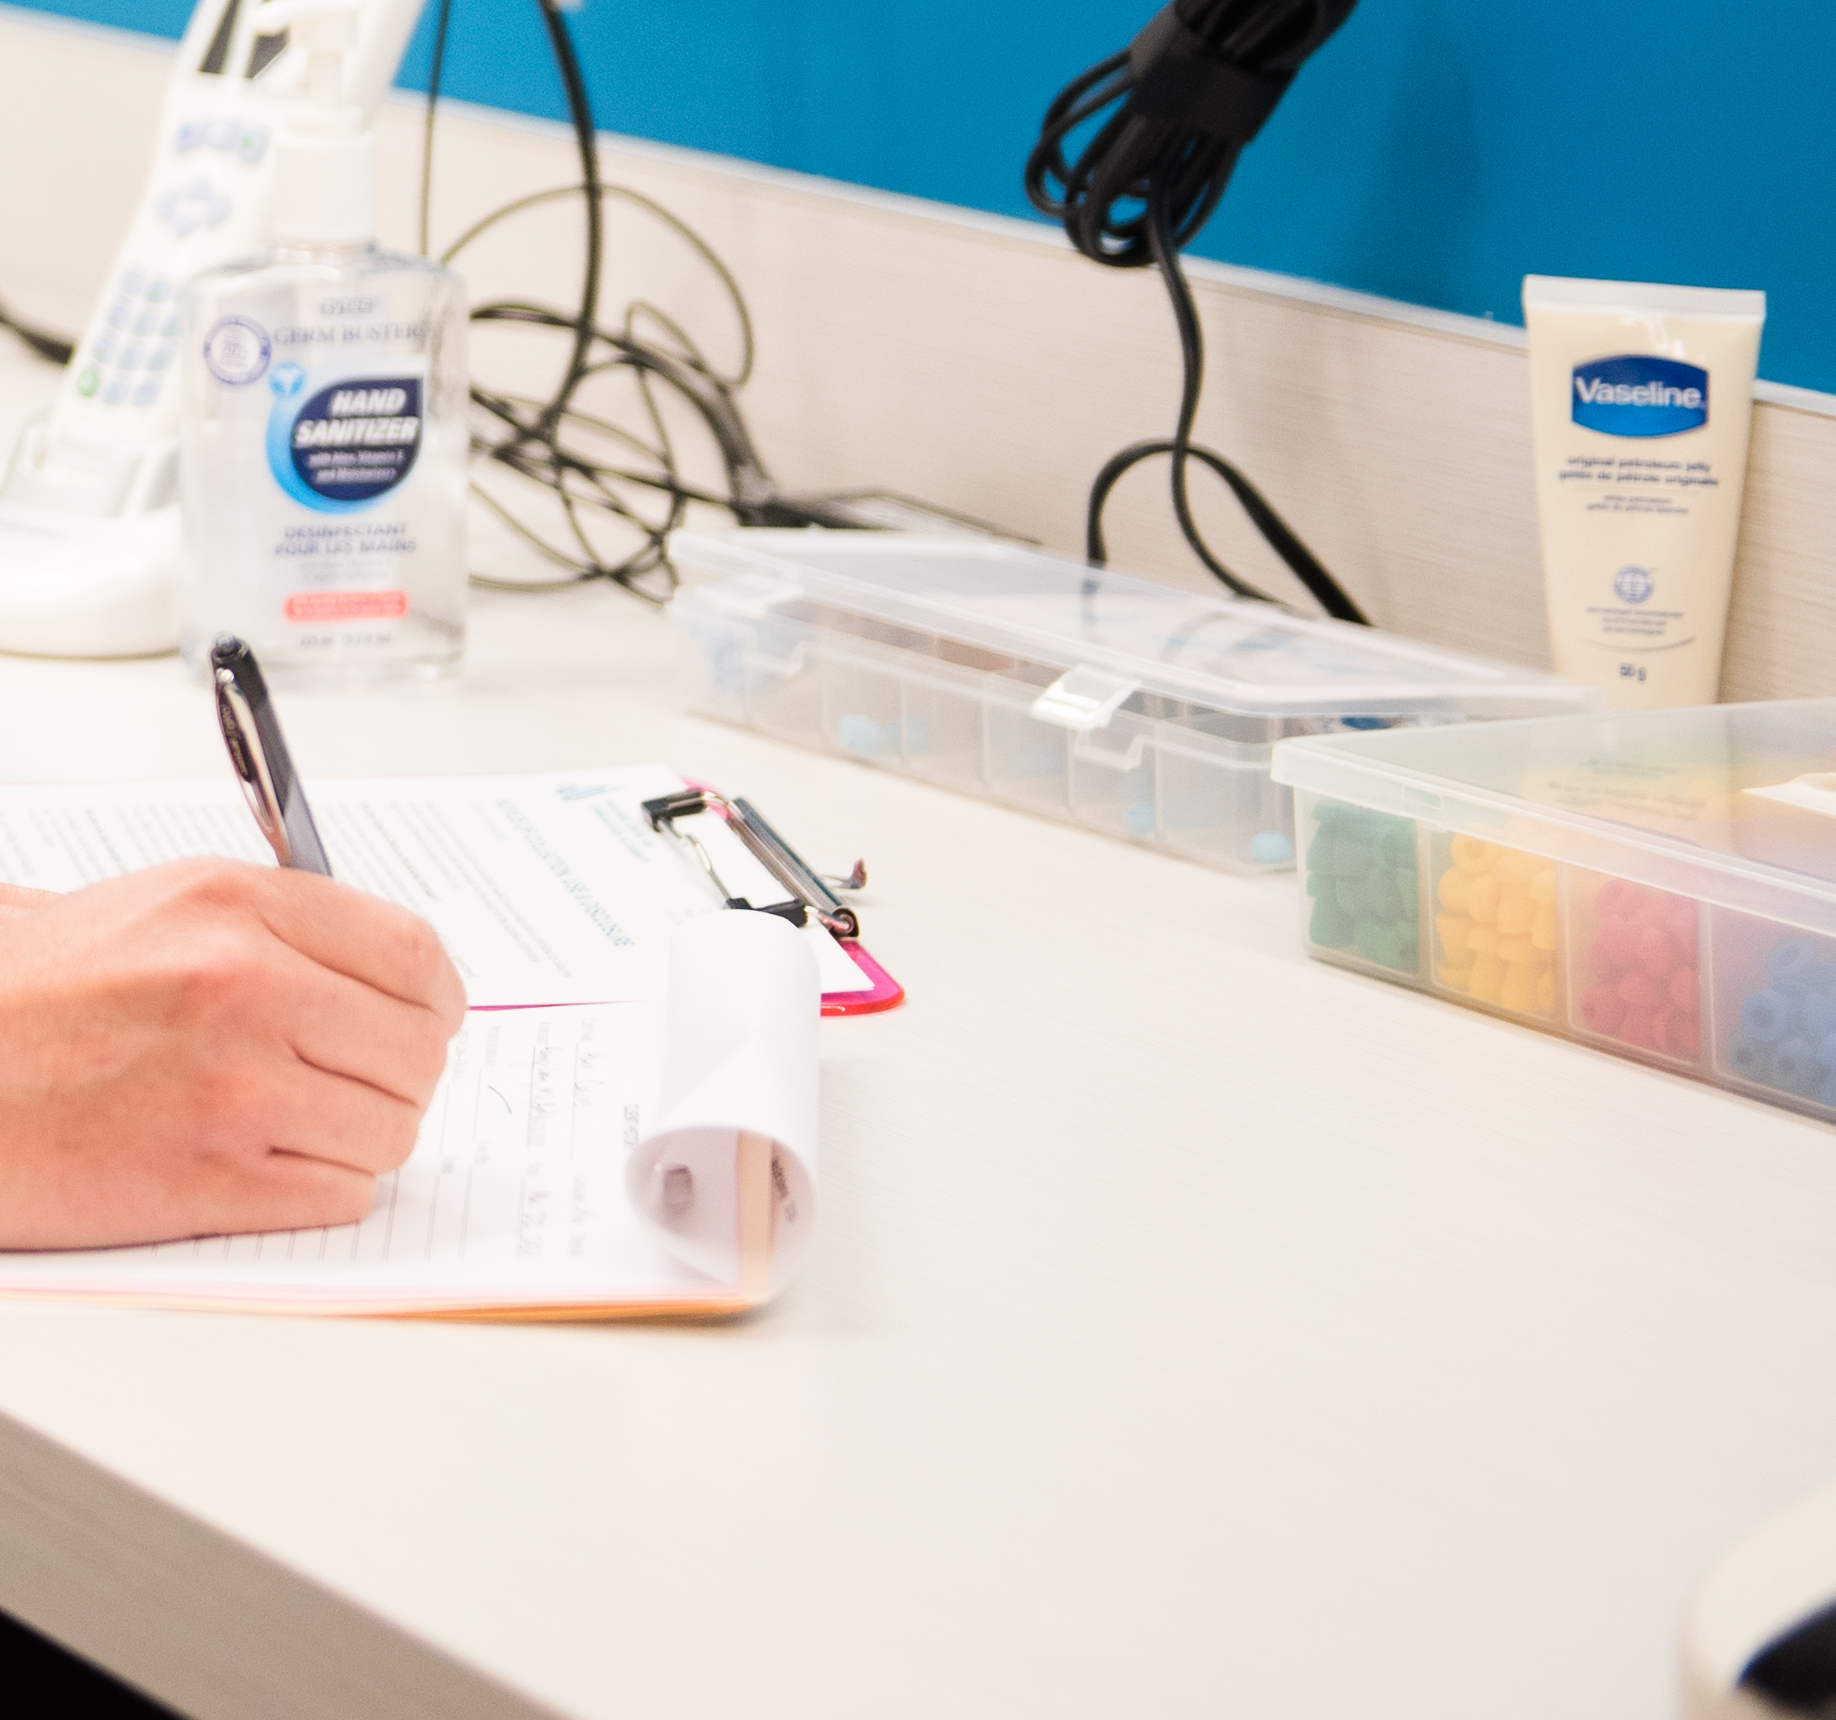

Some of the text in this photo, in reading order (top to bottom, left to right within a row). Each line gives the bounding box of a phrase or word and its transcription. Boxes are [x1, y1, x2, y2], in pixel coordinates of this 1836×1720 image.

[330, 387, 407, 416] HAND
[1574, 376, 1702, 409] Vaseline
[295, 416, 420, 448] SANITIZER
[275, 541, 319, 557] POUR
[360, 536, 418, 554] MAINS
